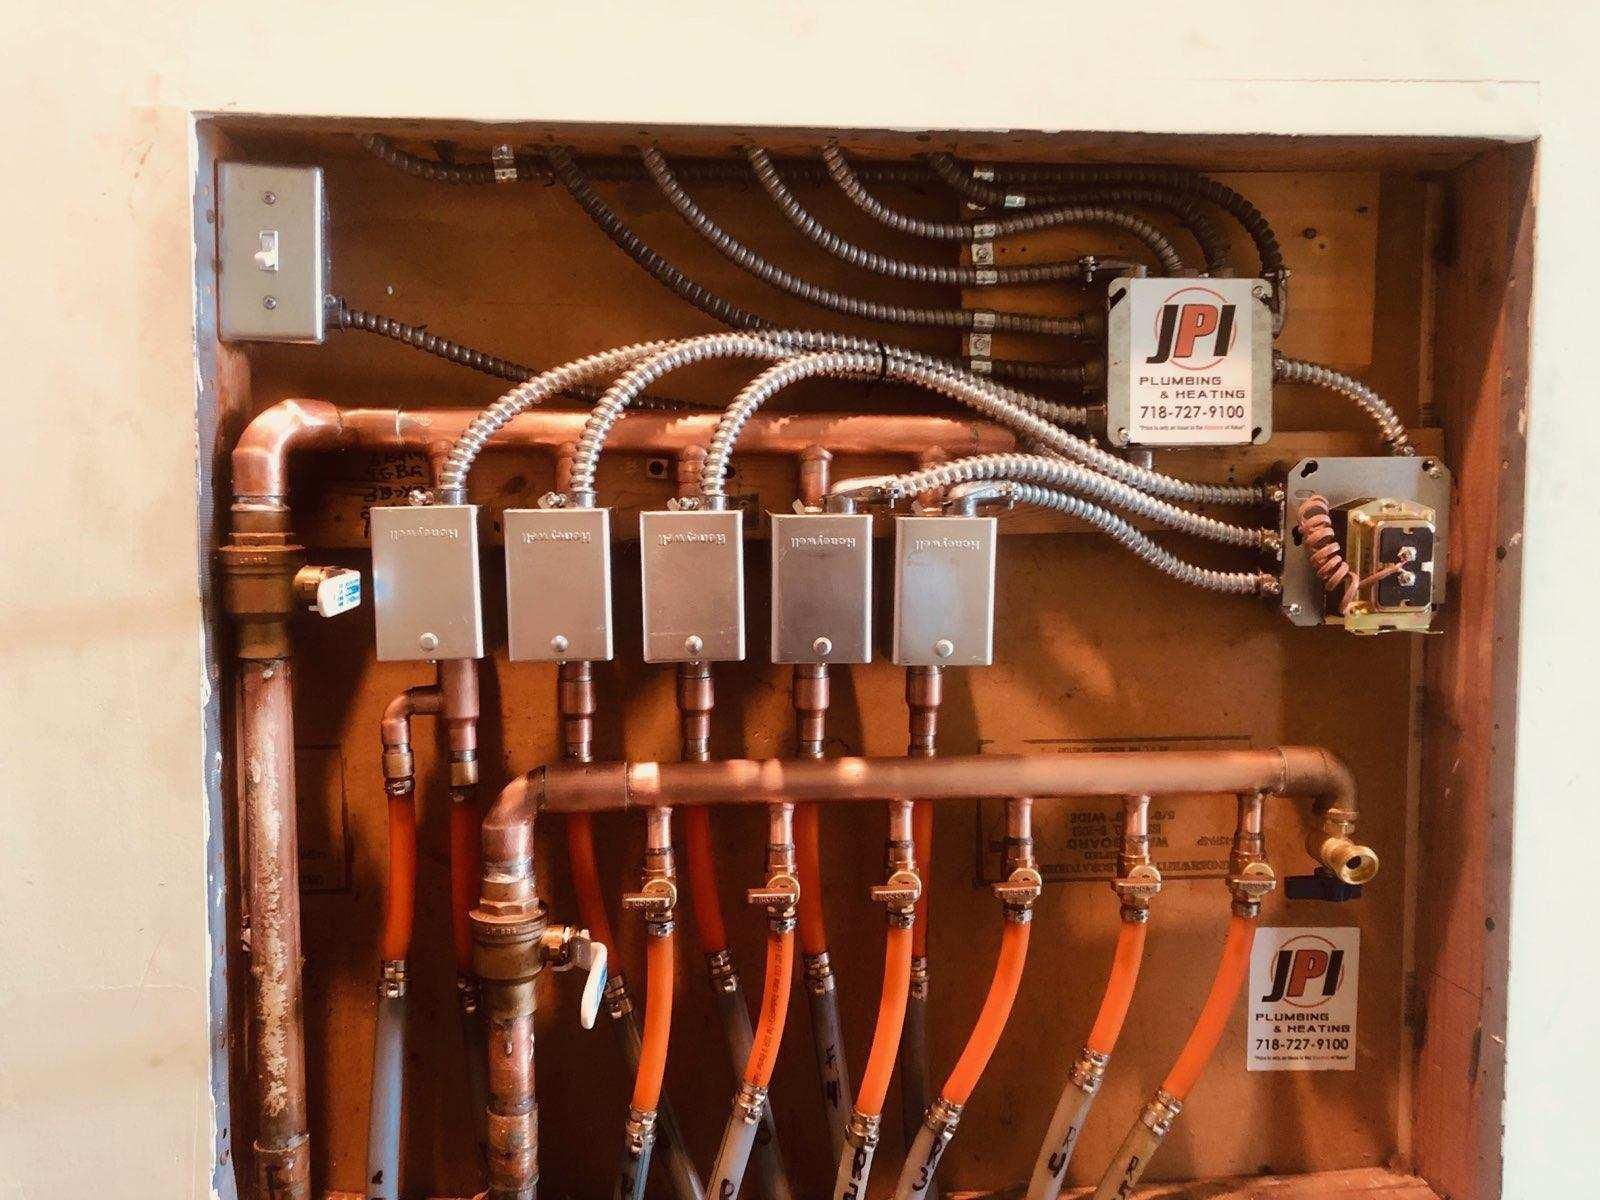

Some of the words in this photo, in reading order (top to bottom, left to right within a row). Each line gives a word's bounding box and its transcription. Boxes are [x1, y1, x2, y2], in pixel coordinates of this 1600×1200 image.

[1145, 303, 1237, 364] JPI
[1139, 376, 1223, 386] PLUMBING
[1160, 390, 1169, 399] &
[1175, 389, 1246, 399] HEATING
[1140, 405, 1245, 419] 718-727-9100
[389, 527, 459, 541] Honeywell
[791, 533, 857, 549] Honeywell
[915, 536, 985, 551] Honeywell
[1261, 949, 1345, 1003] JPI
[1255, 1013, 1330, 1022] PLUMBING
[1273, 1025, 1281, 1033] &
[1287, 1024, 1351, 1033] HEATING
[1256, 1038, 1349, 1051] 718-727-9100
